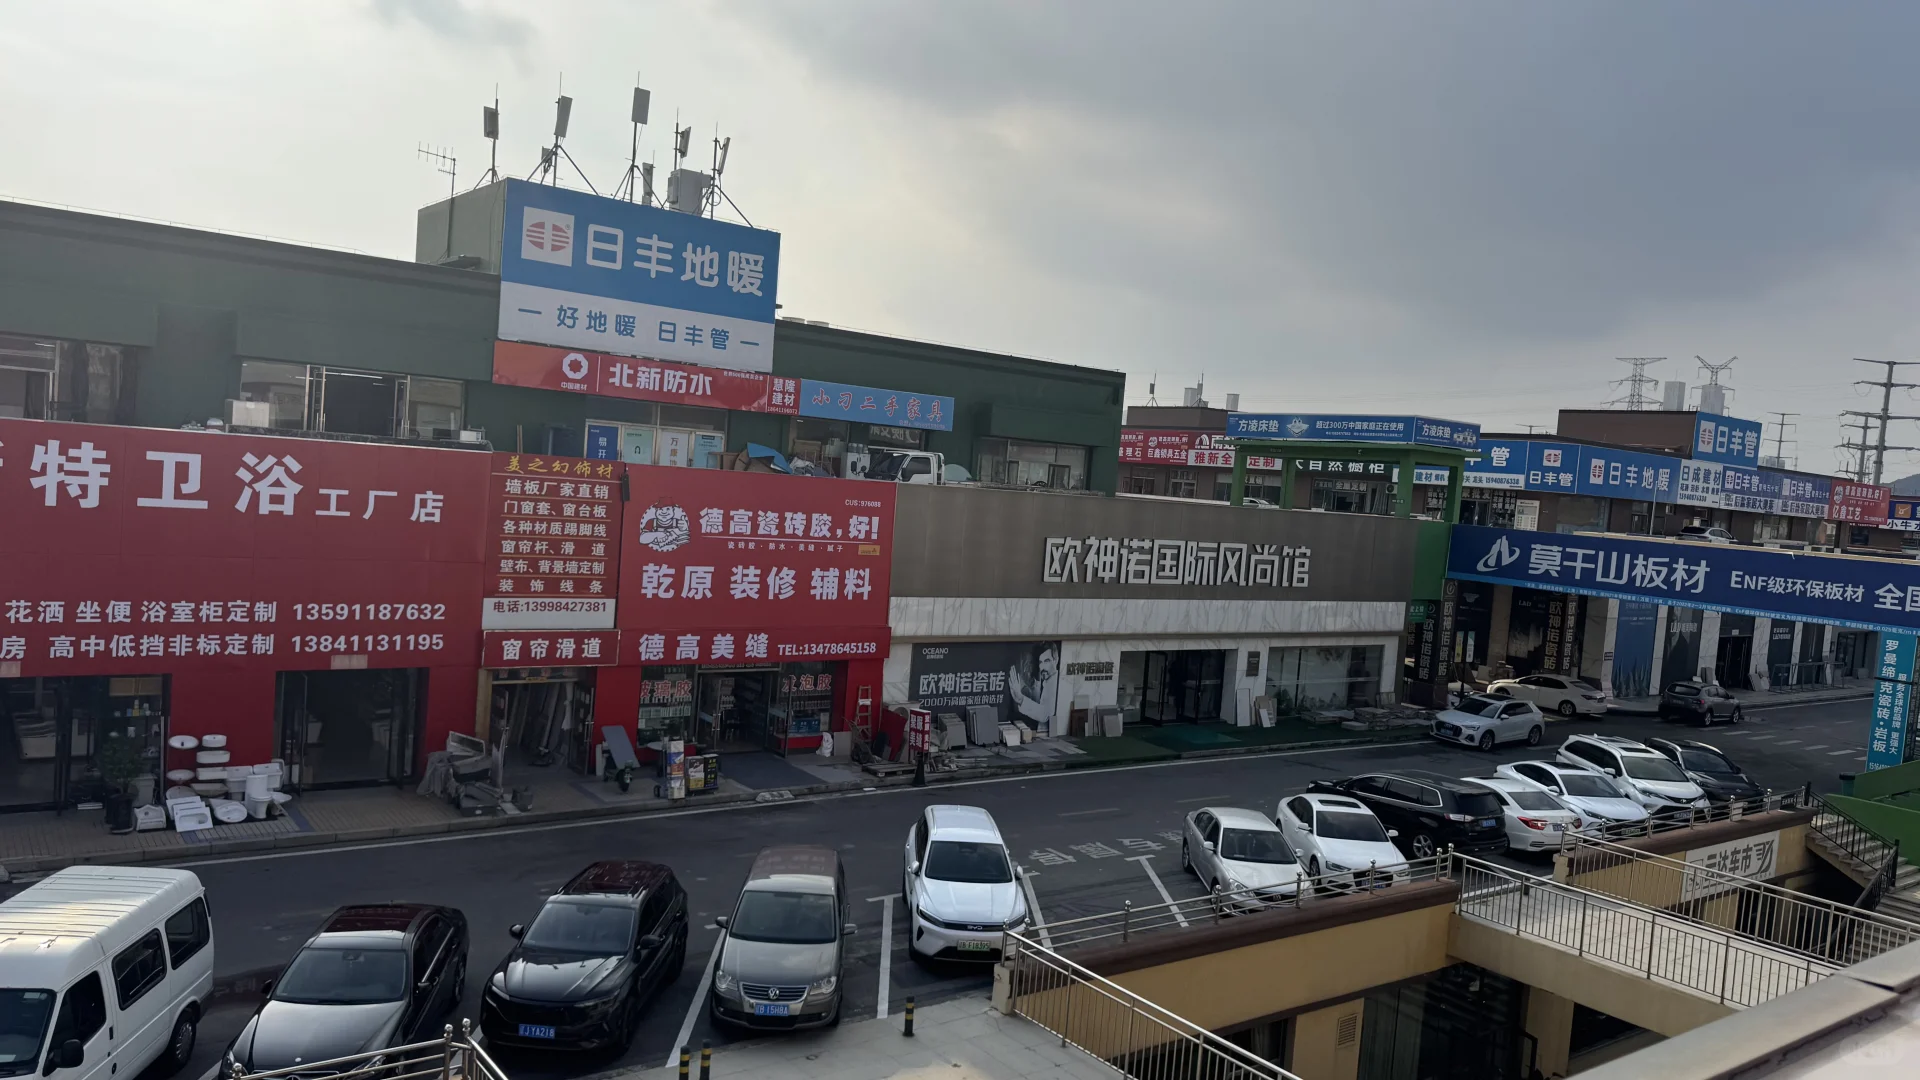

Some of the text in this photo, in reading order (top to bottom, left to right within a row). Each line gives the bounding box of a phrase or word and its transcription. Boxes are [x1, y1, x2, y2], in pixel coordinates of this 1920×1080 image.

[587, 224, 765, 297] 日丰地暖
[557, 304, 730, 351] 好地暖 日丰管
[560, 381, 588, 391] 中国建材
[609, 362, 713, 396] 北新防水
[773, 378, 796, 393] 慧隆
[771, 393, 796, 407] 建材
[1238, 419, 1280, 433] 方凌床垫
[1421, 423, 1452, 439] 方凌床垫
[1715, 425, 1758, 458] 日丰管
[0, 439, 304, 516] 特卫浴
[504, 455, 614, 479] 美之幻饰材
[1414, 471, 1433, 482] 建材
[1529, 470, 1574, 487] 日丰管
[1609, 462, 1671, 492] 日丰地暖
[1681, 465, 1722, 487] 日成建材
[505, 478, 610, 500] 墙板厂家直销
[1734, 472, 1760, 492] 日丰管
[1790, 480, 1813, 499] 日丰管
[315, 488, 445, 524] 工厂店
[504, 499, 607, 519] 门窗套、窗台板
[502, 519, 607, 538] 各种材质踢脚线
[499, 559, 606, 575] 壁布、背景墙定制
[1043, 536, 1312, 587] 欧神诺国际风尚馆
[1528, 543, 1711, 593] 莫干山板材
[1730, 571, 1866, 603] ENF级环保板材
[641, 563, 872, 601] 乾原 装修 辅料
[6, 601, 447, 624] 花洒 坐便 浴室柜定制 13591187632
[493, 600, 607, 614] 电话:13998427381
[48, 633, 276, 659] 高中低挡非标定制
[290, 633, 445, 654] 13841131195
[639, 632, 877, 661] 德高美缝 TEL:13478645158
[1438, 601, 1454, 676] 欧神诺瓷砖
[1543, 601, 1563, 671] 欧神诺瓷砖
[1562, 601, 1577, 670] 欧神诺瓷砖
[501, 637, 602, 661] 窗帘滑道
[922, 647, 949, 655] OCEANO
[918, 671, 1006, 695] 欧神诺瓷砖
[918, 694, 1005, 707] 2000万高端家庭的选择
